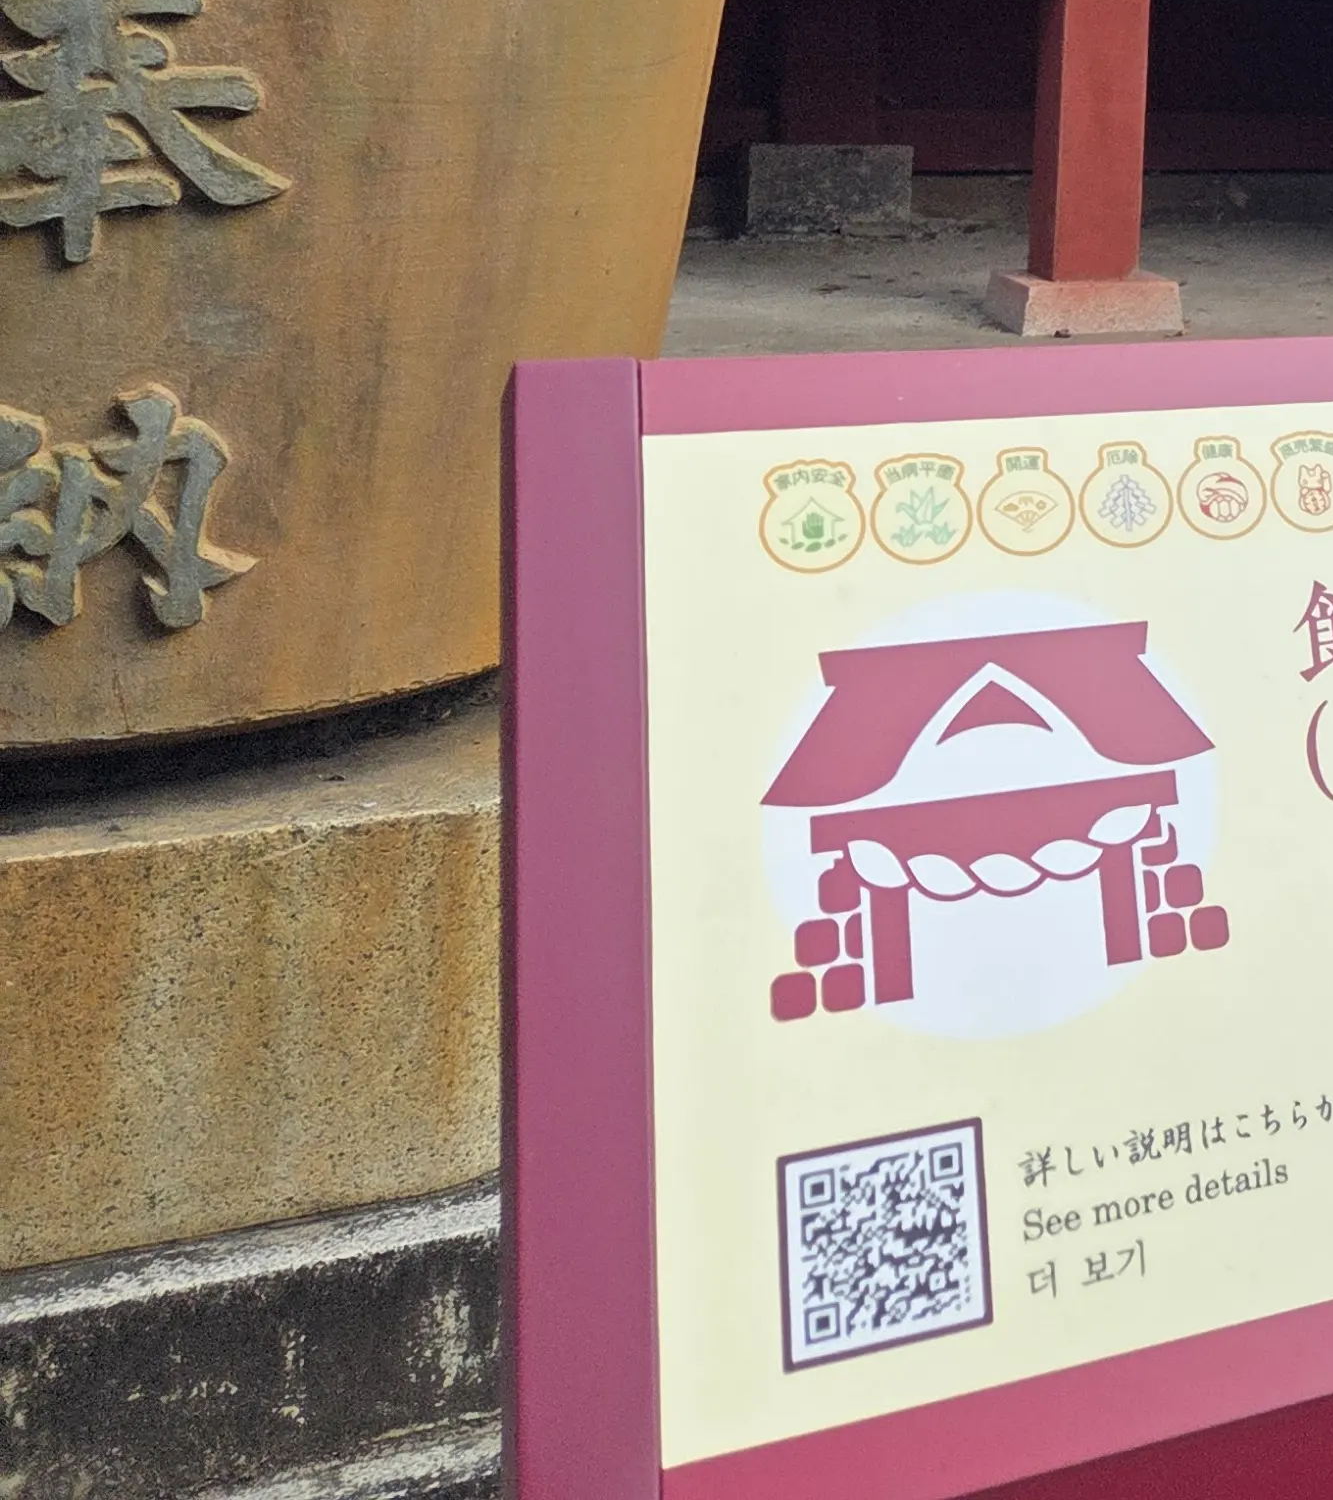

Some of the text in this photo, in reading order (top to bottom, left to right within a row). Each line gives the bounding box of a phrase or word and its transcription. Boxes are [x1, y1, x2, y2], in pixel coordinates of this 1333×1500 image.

[1022, 1158, 1290, 1242] See more details
[1026, 1238, 1147, 1299] 더 보기
